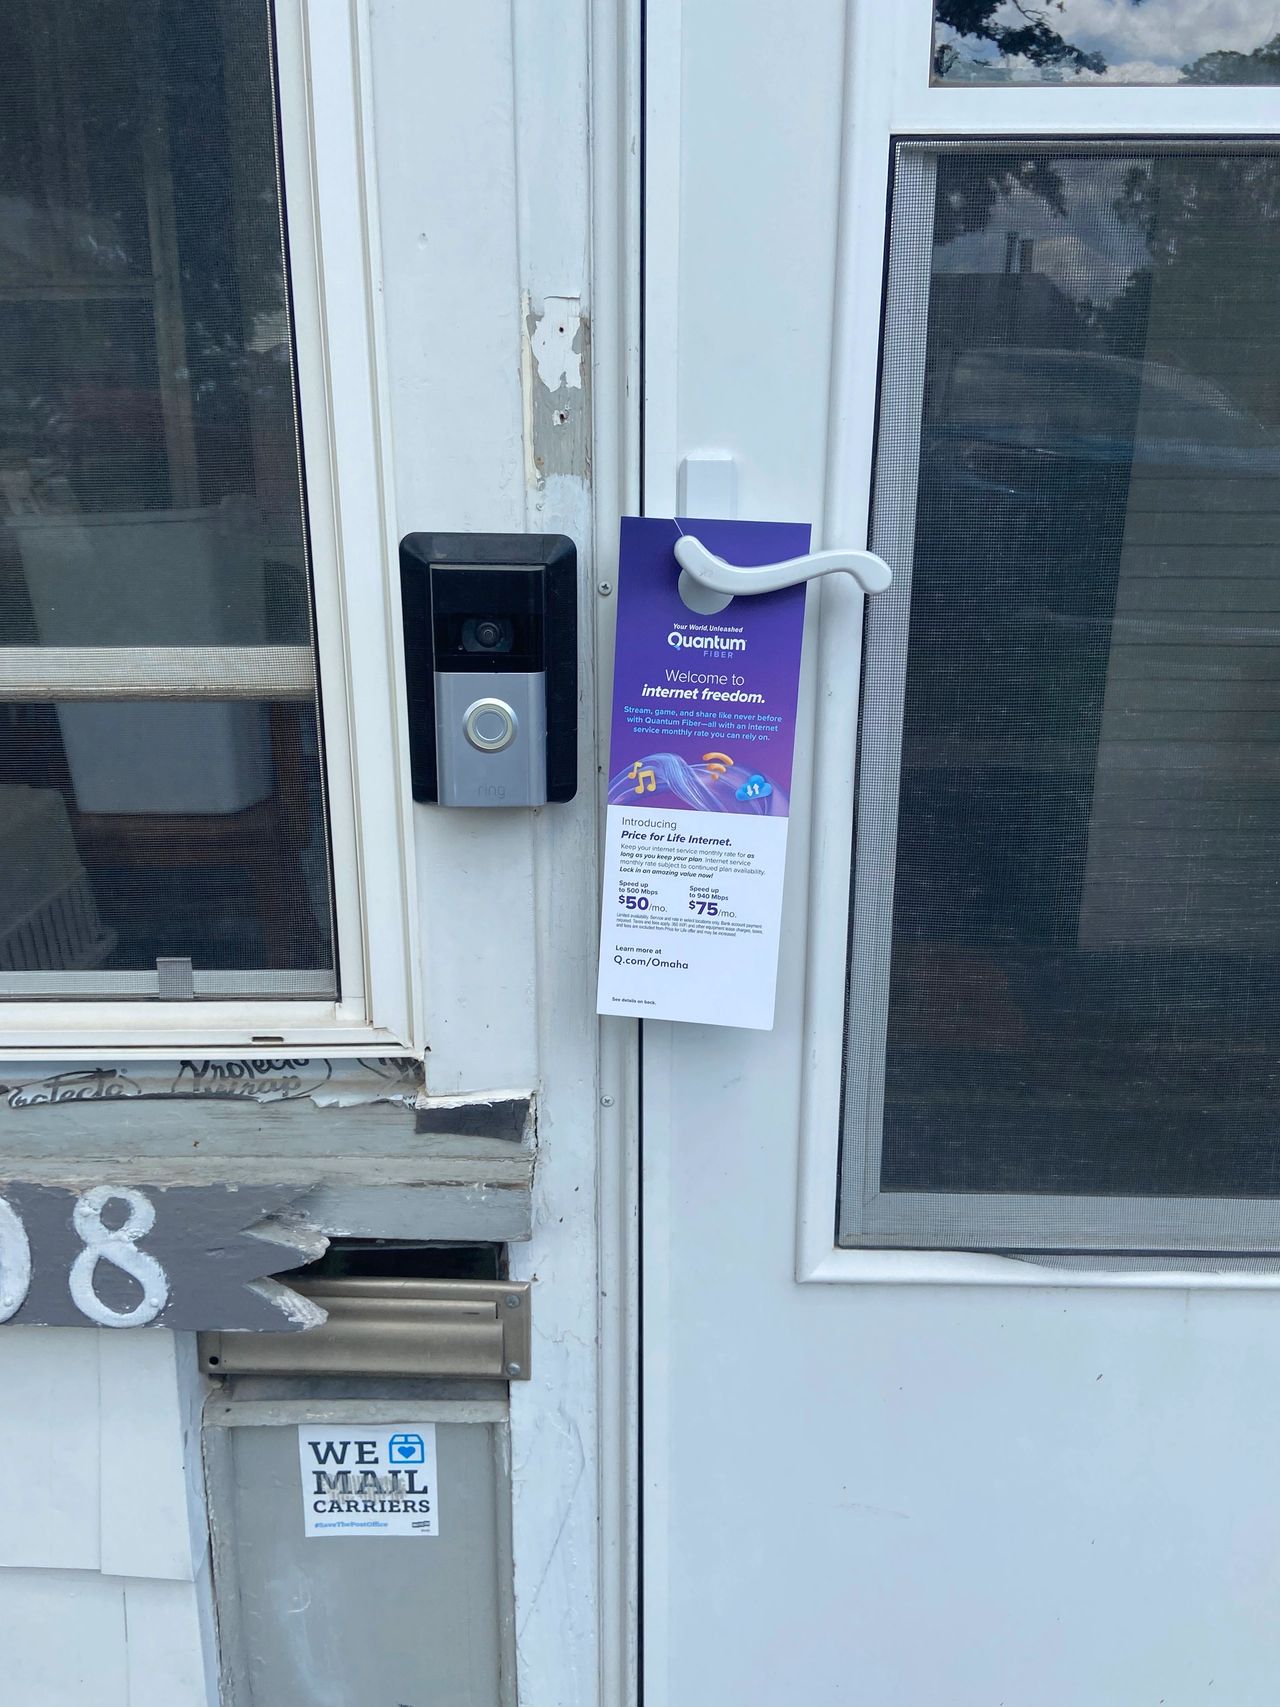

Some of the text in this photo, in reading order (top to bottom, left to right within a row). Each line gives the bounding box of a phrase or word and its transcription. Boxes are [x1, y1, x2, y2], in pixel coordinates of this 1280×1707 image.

[709, 625, 743, 633] Unleashed
[667, 631, 746, 651] Quantum
[703, 650, 733, 658] FIBER
[665, 669, 745, 686] Welcome to
[642, 684, 765, 703] internet freedom.
[624, 706, 652, 715] Stream,
[757, 714, 782, 722] before
[645, 717, 680, 725] Quantum
[662, 728, 692, 737] monthly
[711, 731, 724, 739] you
[742, 732, 756, 741] rely
[478, 784, 505, 799] ring
[622, 817, 677, 831] Introducing
[621, 830, 732, 847] Price for Life Internet.
[652, 869, 678, 877] amazing
[613, 955, 689, 969] Q.com/Omaha
[308, 1441, 379, 1464] WE
[312, 1470, 428, 1494] MAIL
[313, 1500, 430, 1513] CARRIERS
